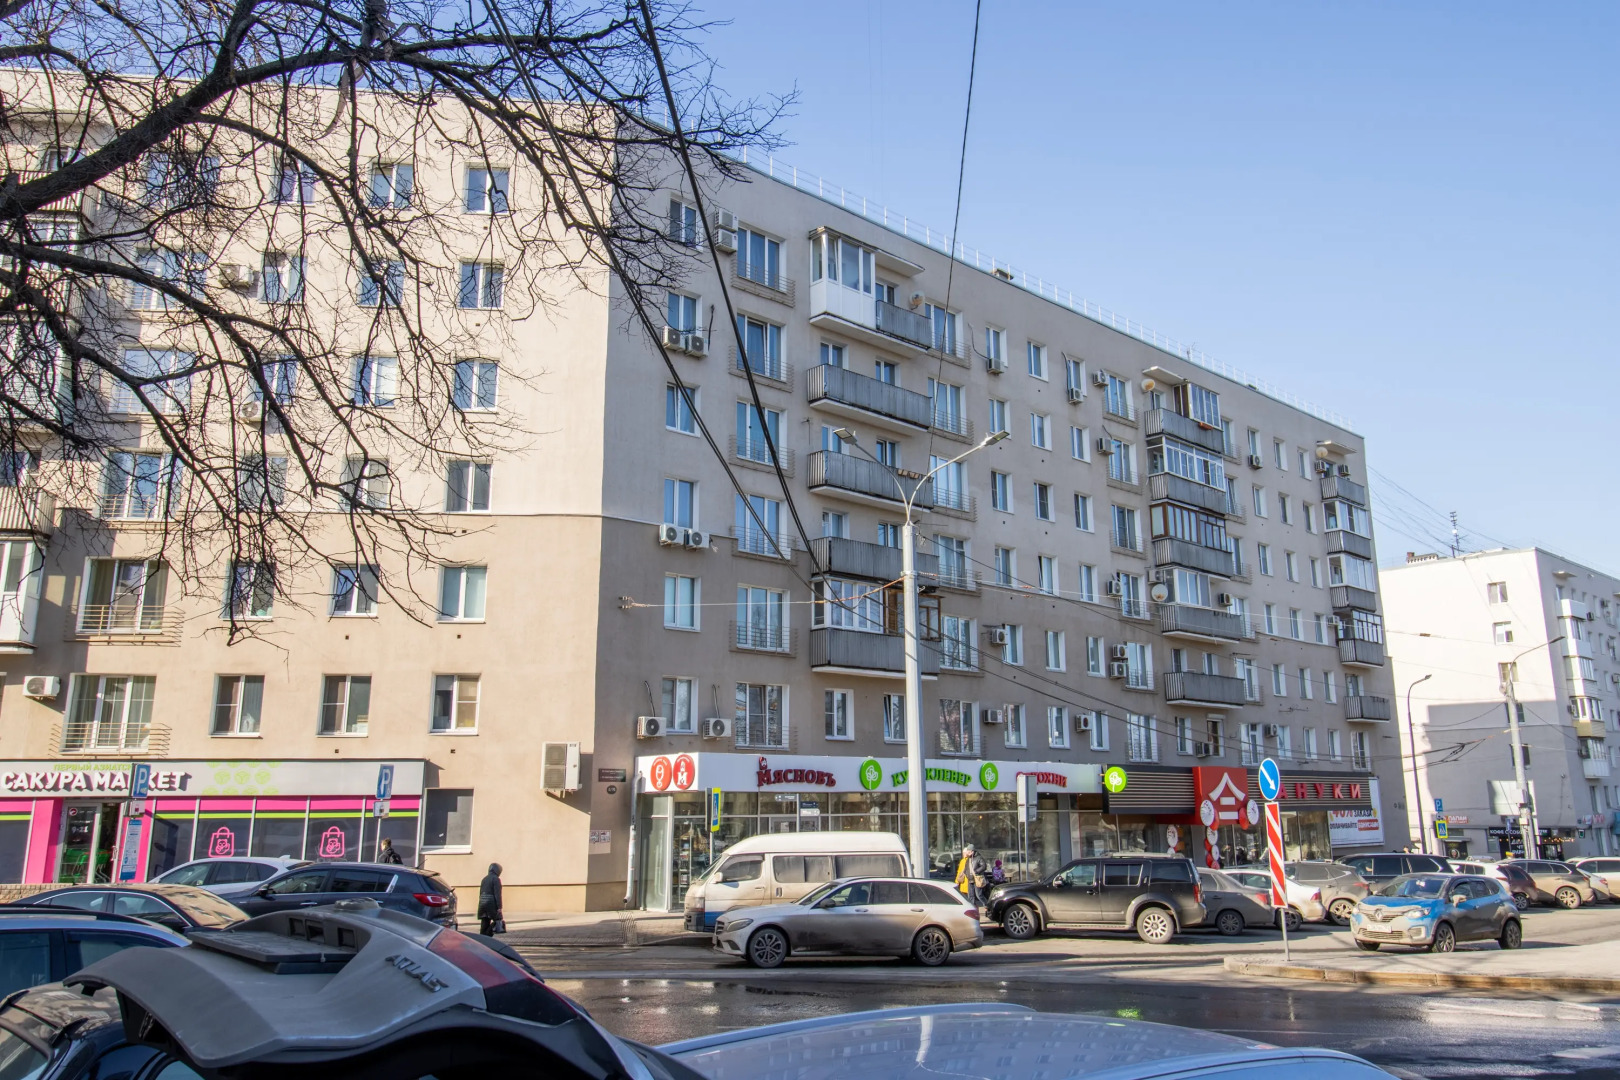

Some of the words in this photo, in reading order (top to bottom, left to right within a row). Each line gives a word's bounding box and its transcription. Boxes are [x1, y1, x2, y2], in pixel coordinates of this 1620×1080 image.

[53, 762, 91, 771] ПЕРВЫЙ
[1, 771, 91, 791] САКУРА
[94, 771, 190, 791] МАКЕТ
[757, 769, 836, 787] МЯСНОВЪ
[891, 767, 972, 787] КУКЛЕВЕР
[1257, 783, 1361, 799] АНУКИ
[385, 954, 449, 993] ATLAS
